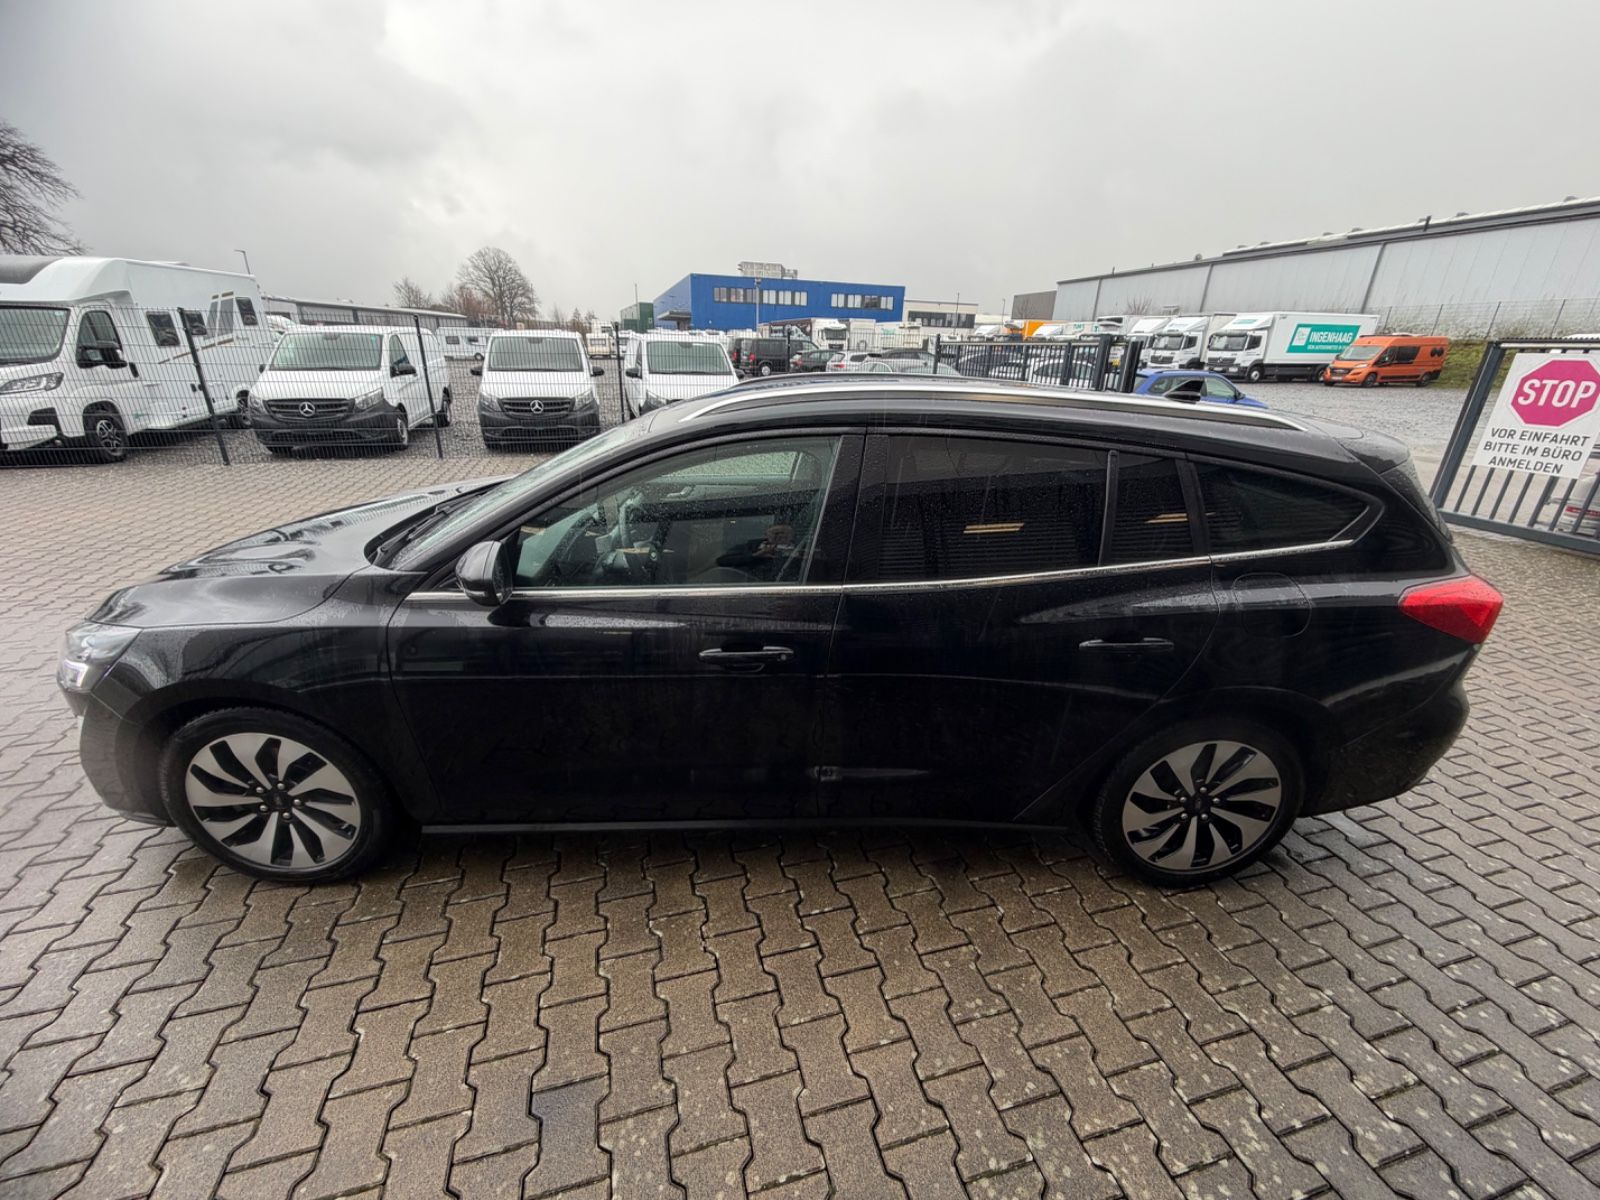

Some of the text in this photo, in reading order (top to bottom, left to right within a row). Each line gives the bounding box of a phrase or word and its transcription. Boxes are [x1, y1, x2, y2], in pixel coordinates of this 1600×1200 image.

[1309, 331, 1353, 343] INGENHAAG
[1517, 378, 1597, 408] STOP
[1491, 427, 1590, 446] VOR EINFAHRT
[1483, 441, 1583, 461] BITTE IM BÜRO
[1488, 456, 1564, 474] ANMELDEN
